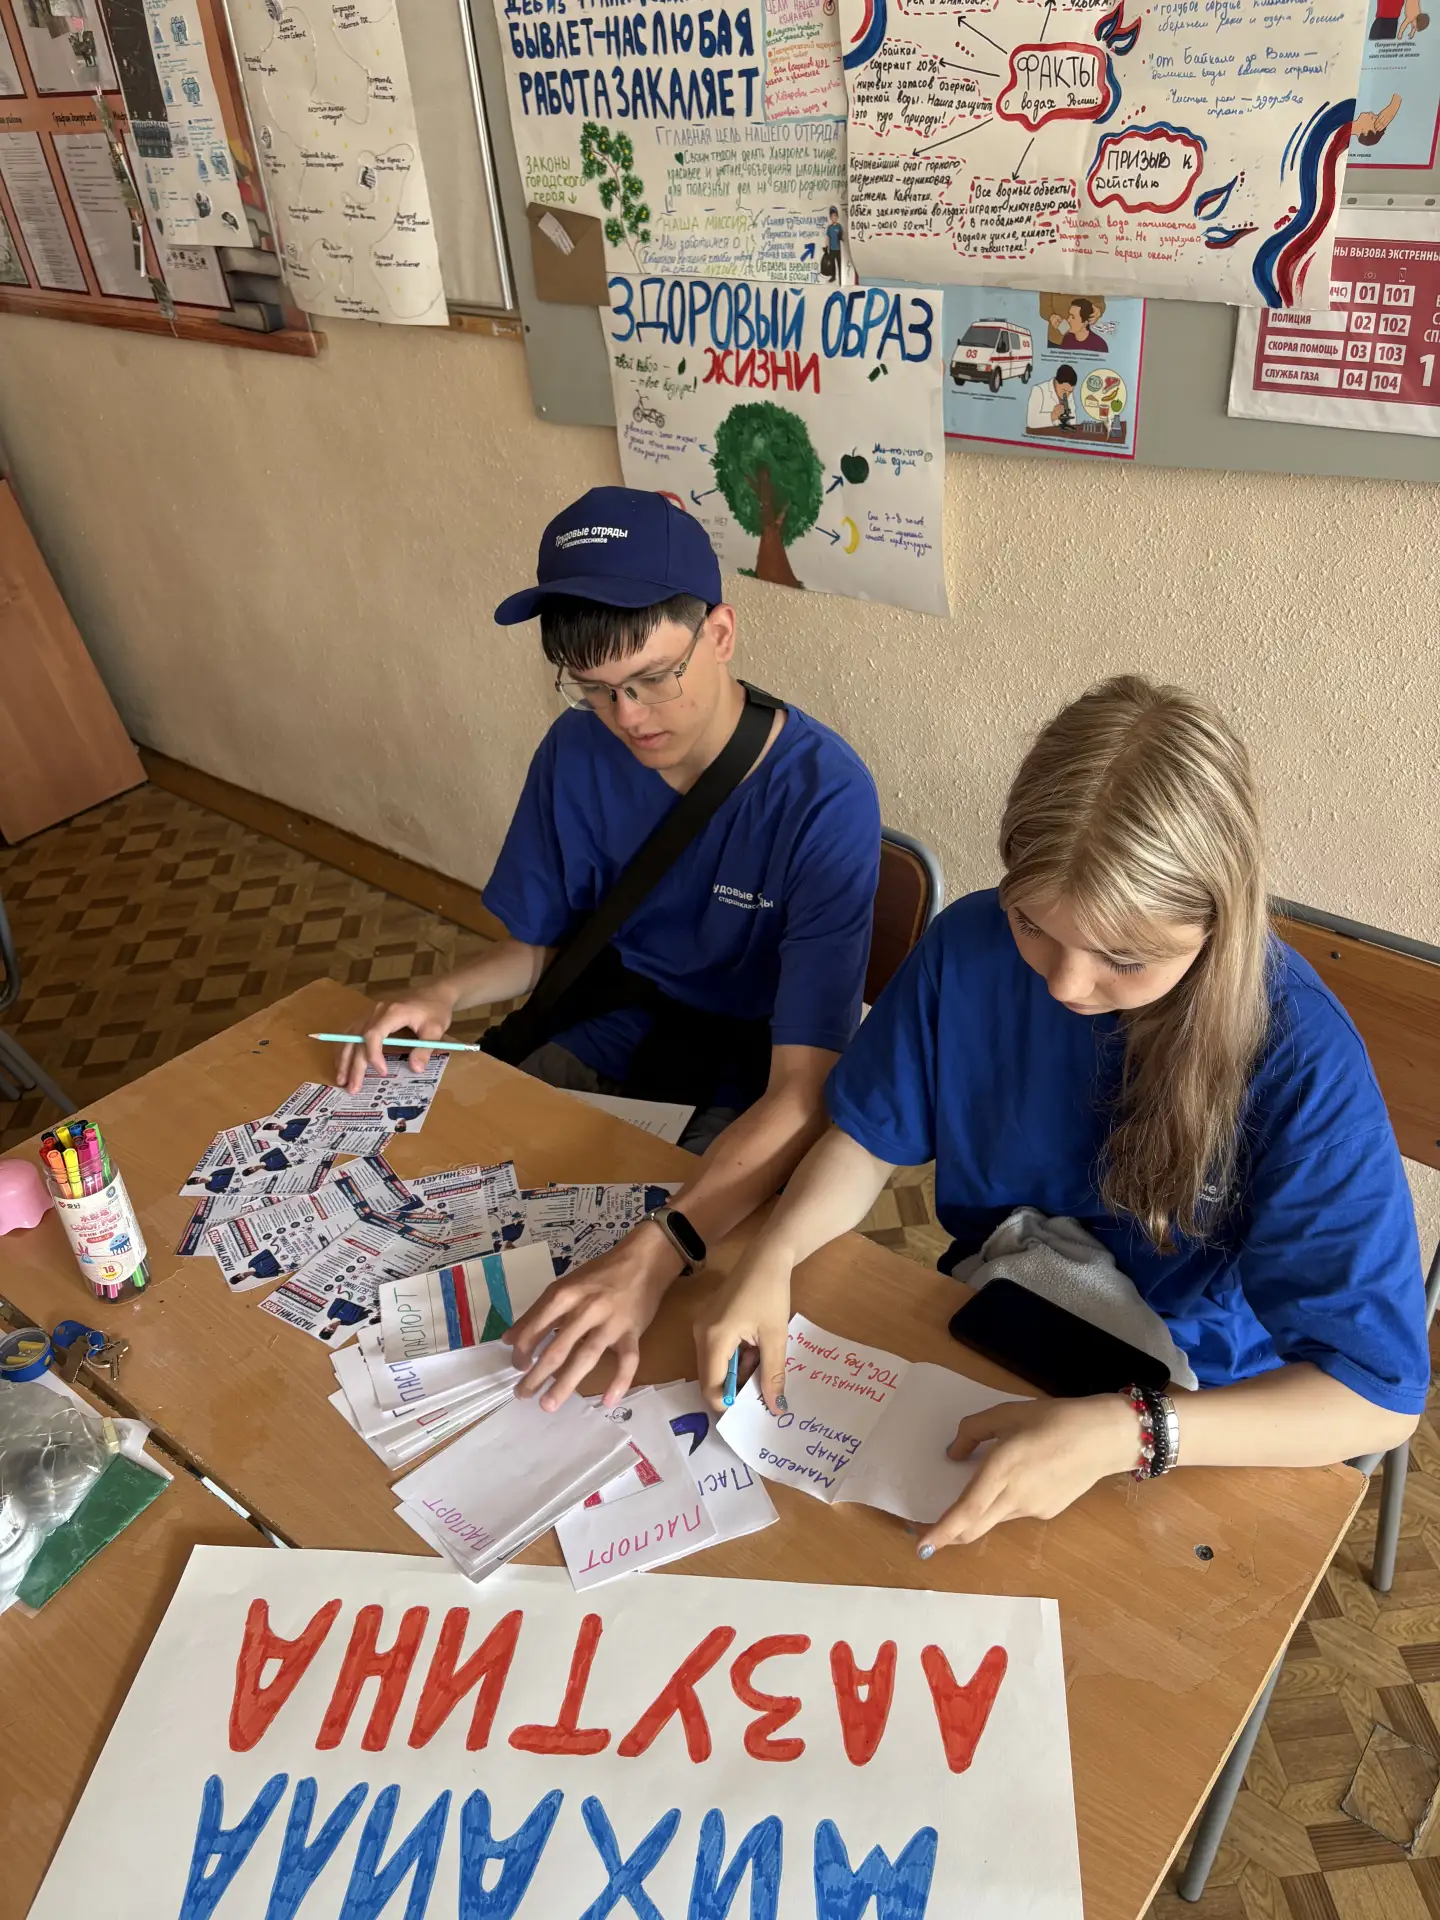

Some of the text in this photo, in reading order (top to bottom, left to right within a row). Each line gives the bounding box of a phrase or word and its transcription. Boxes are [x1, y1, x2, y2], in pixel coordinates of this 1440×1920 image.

[652, 8, 755, 59] ЛЮБАЯ
[917, 59, 937, 73] 20%
[1017, 54, 1096, 91] ФАКТЫ
[1246, 54, 1257, 70] до
[857, 79, 893, 89] мировых
[897, 76, 935, 91] запасов
[1021, 91, 1056, 122] водах
[904, 111, 946, 134] природы!
[715, 127, 742, 145] ЦЕЛЬ
[745, 125, 790, 145] НАШЕГО
[526, 155, 570, 174] ЗАКОНЫ
[903, 161, 922, 172] очаг
[1107, 149, 1171, 171] ПРИЗЫВ
[525, 174, 587, 190] ГОРОДСКОГО
[975, 184, 991, 198] Все
[851, 191, 887, 202] система
[969, 204, 1002, 216] играют
[1008, 202, 1056, 213] ключевую
[990, 230, 1019, 247] цикле,
[1021, 228, 1055, 239] климате
[1350, 247, 1386, 259] ВЫЗОВА
[1358, 286, 1376, 300] 01
[1386, 287, 1410, 303] 101
[608, 278, 934, 363] ЗДОРОВЫЙ ОБРАЗ
[1271, 312, 1407, 333] ПОЛИЦИЯ 02 102
[966, 349, 977, 358] 03
[1268, 340, 1403, 362] СКОРАЯ ПОМОЩЬ 03 103
[702, 347, 820, 394] ЖИЗНИ
[1264, 369, 1398, 391] СЛУЖБА ГАЗА 04 104
[555, 526, 629, 548] Трудовые отряды
[412, 1171, 457, 1187] ЛАЗУТИН
[103, 1265, 116, 1274] 18
[279, 1308, 320, 1332] ЛАЗУТИН
[394, 1287, 429, 1359] ПАСПОРТ
[421, 1498, 497, 1551] ПАСПОРТ
[579, 1505, 701, 1574] ПАСПОРТ
[228, 1598, 1008, 1774] ЛАЗУТИНА
[178, 1772, 938, 1920] МИХАИЛА
